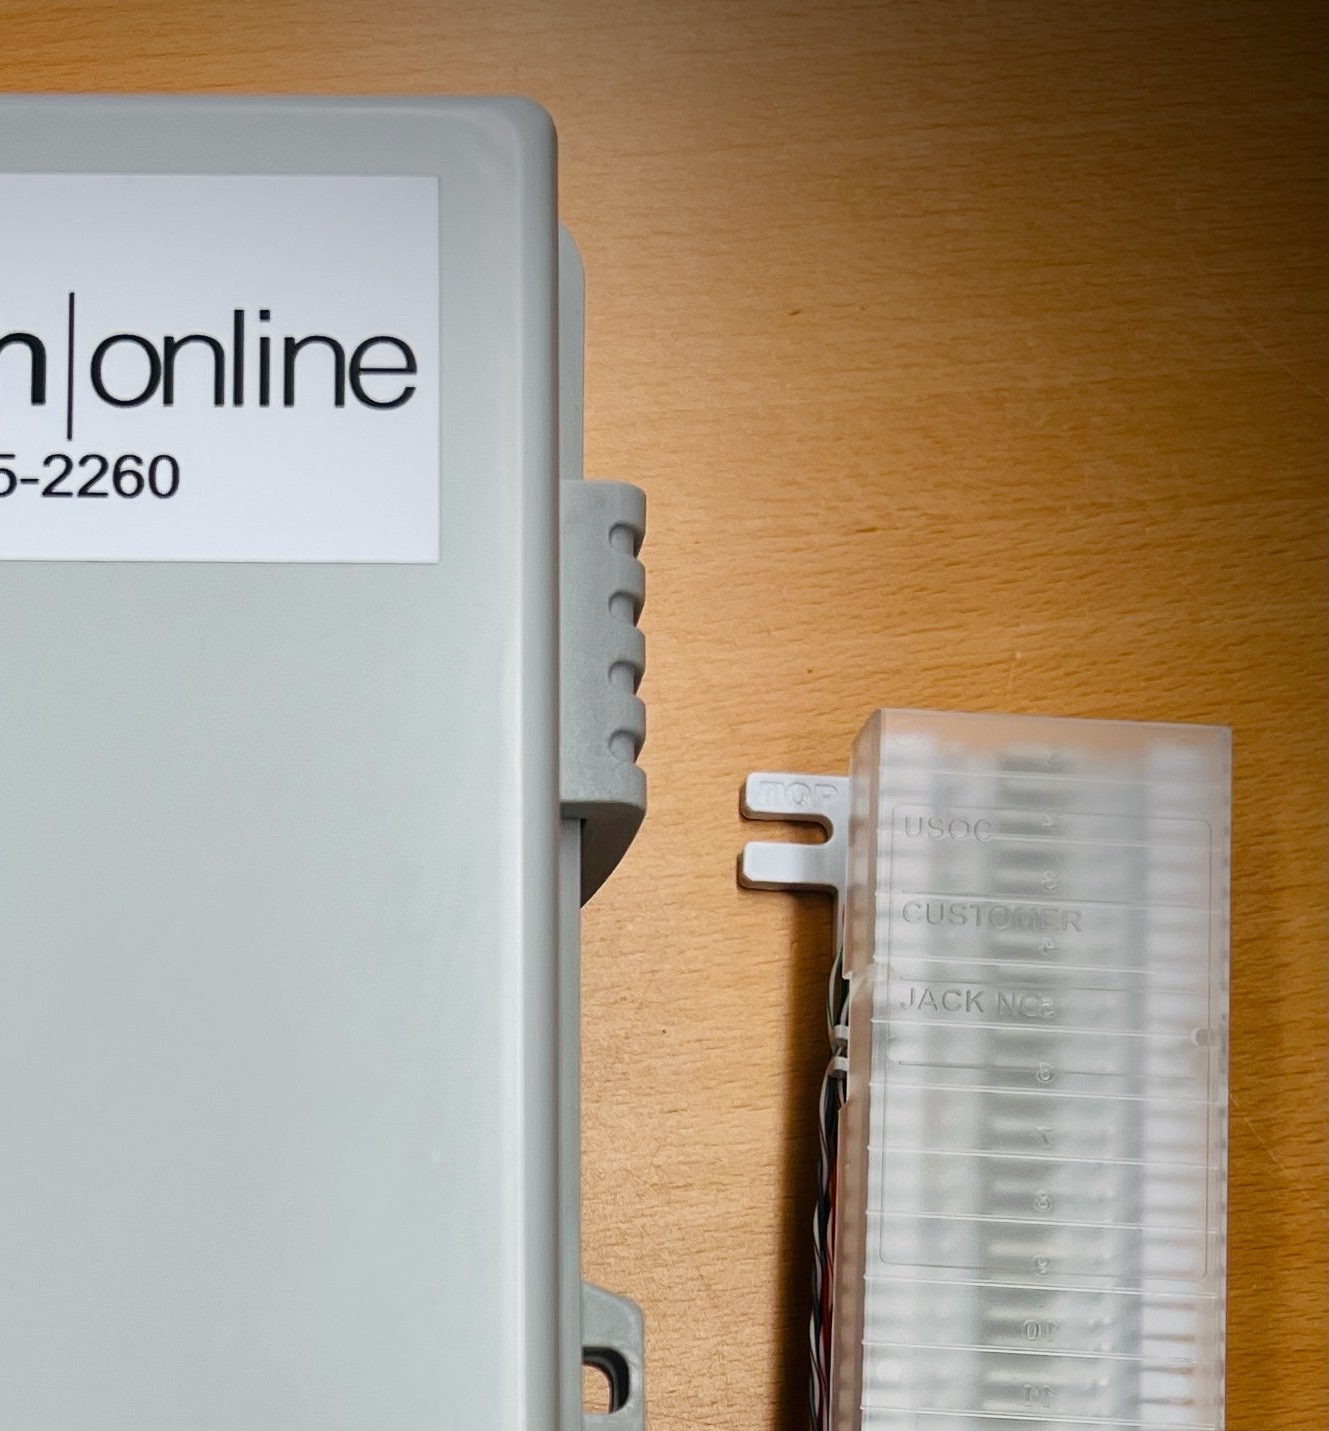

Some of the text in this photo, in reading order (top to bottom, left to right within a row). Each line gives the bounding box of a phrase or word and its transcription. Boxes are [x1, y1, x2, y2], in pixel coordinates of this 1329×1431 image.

[90, 309, 418, 410] online
[758, 780, 839, 808] TOP
[904, 815, 992, 842] USOC
[901, 900, 1083, 932] CUSTOMER
[899, 986, 985, 1014] JACK
